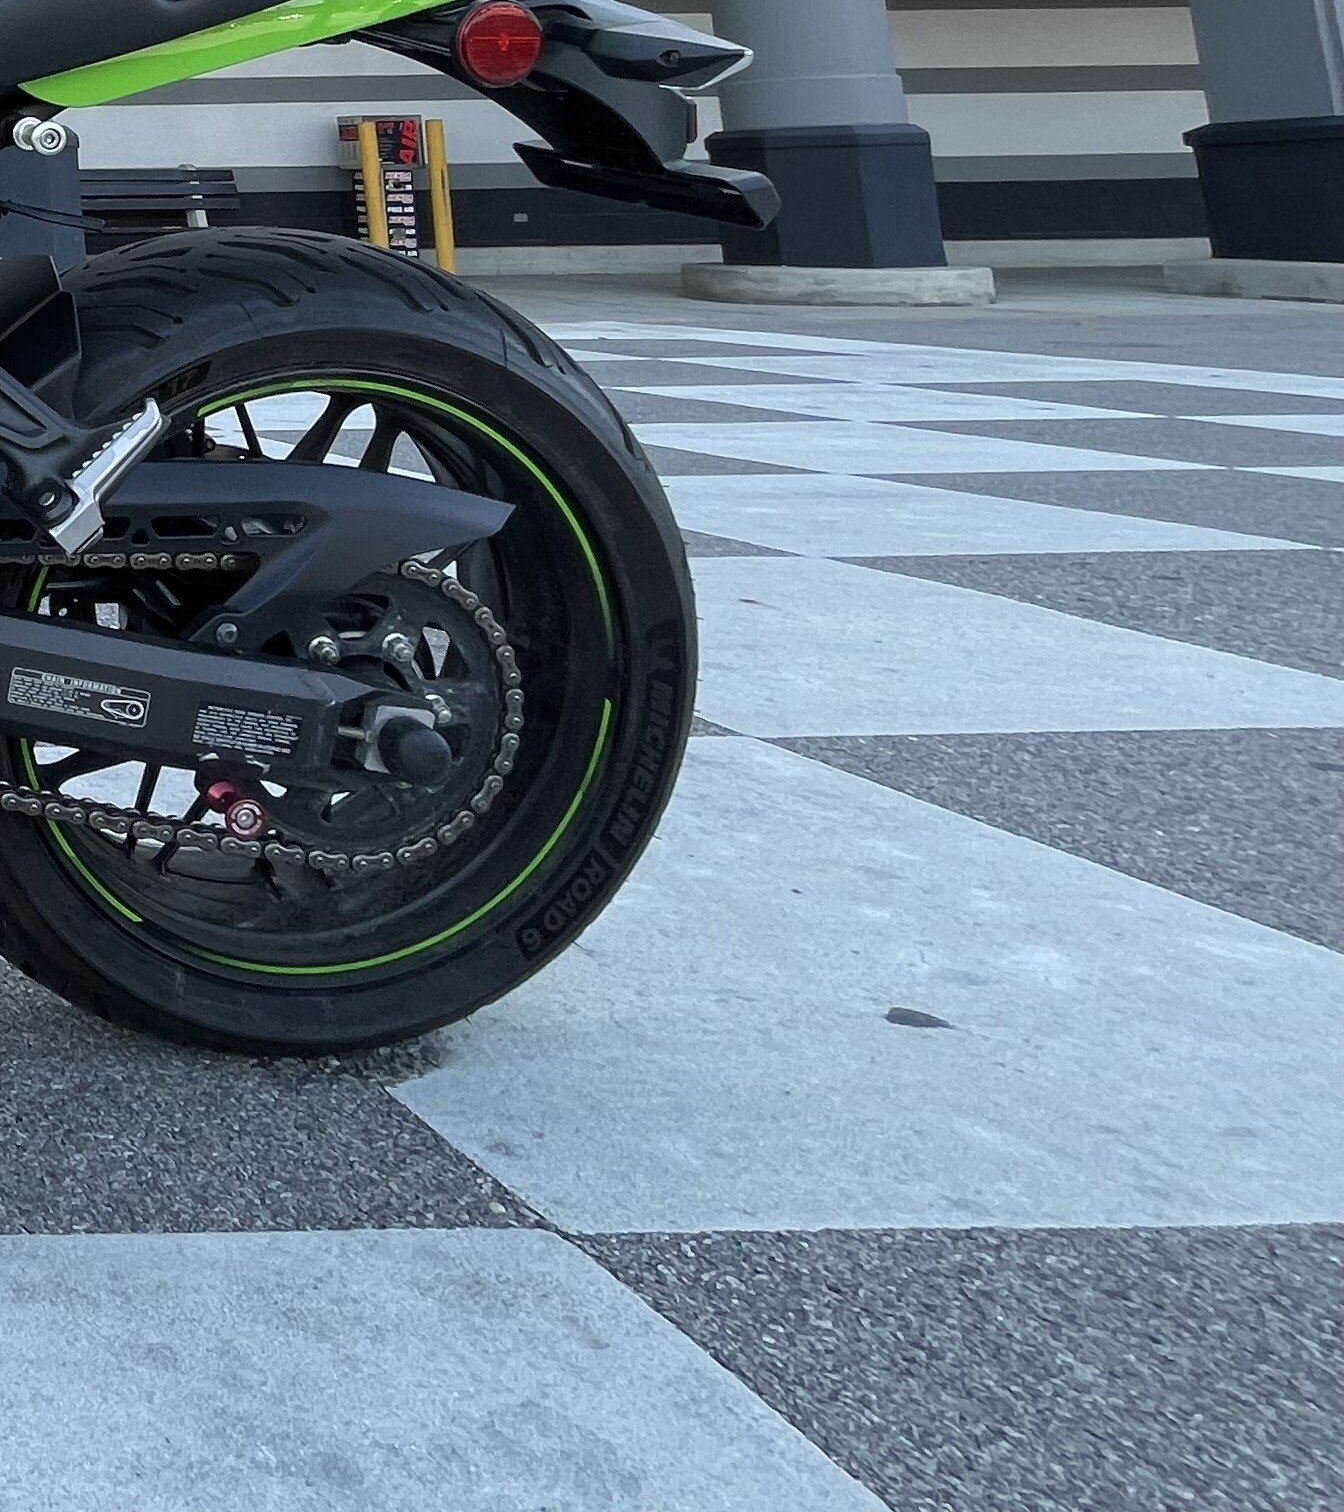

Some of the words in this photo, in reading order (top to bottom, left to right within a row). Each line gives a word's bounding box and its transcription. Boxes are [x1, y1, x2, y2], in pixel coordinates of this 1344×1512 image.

[610, 681, 675, 844] MICHELIN
[542, 857, 608, 933] ROAD
[519, 928, 543, 952] 6
